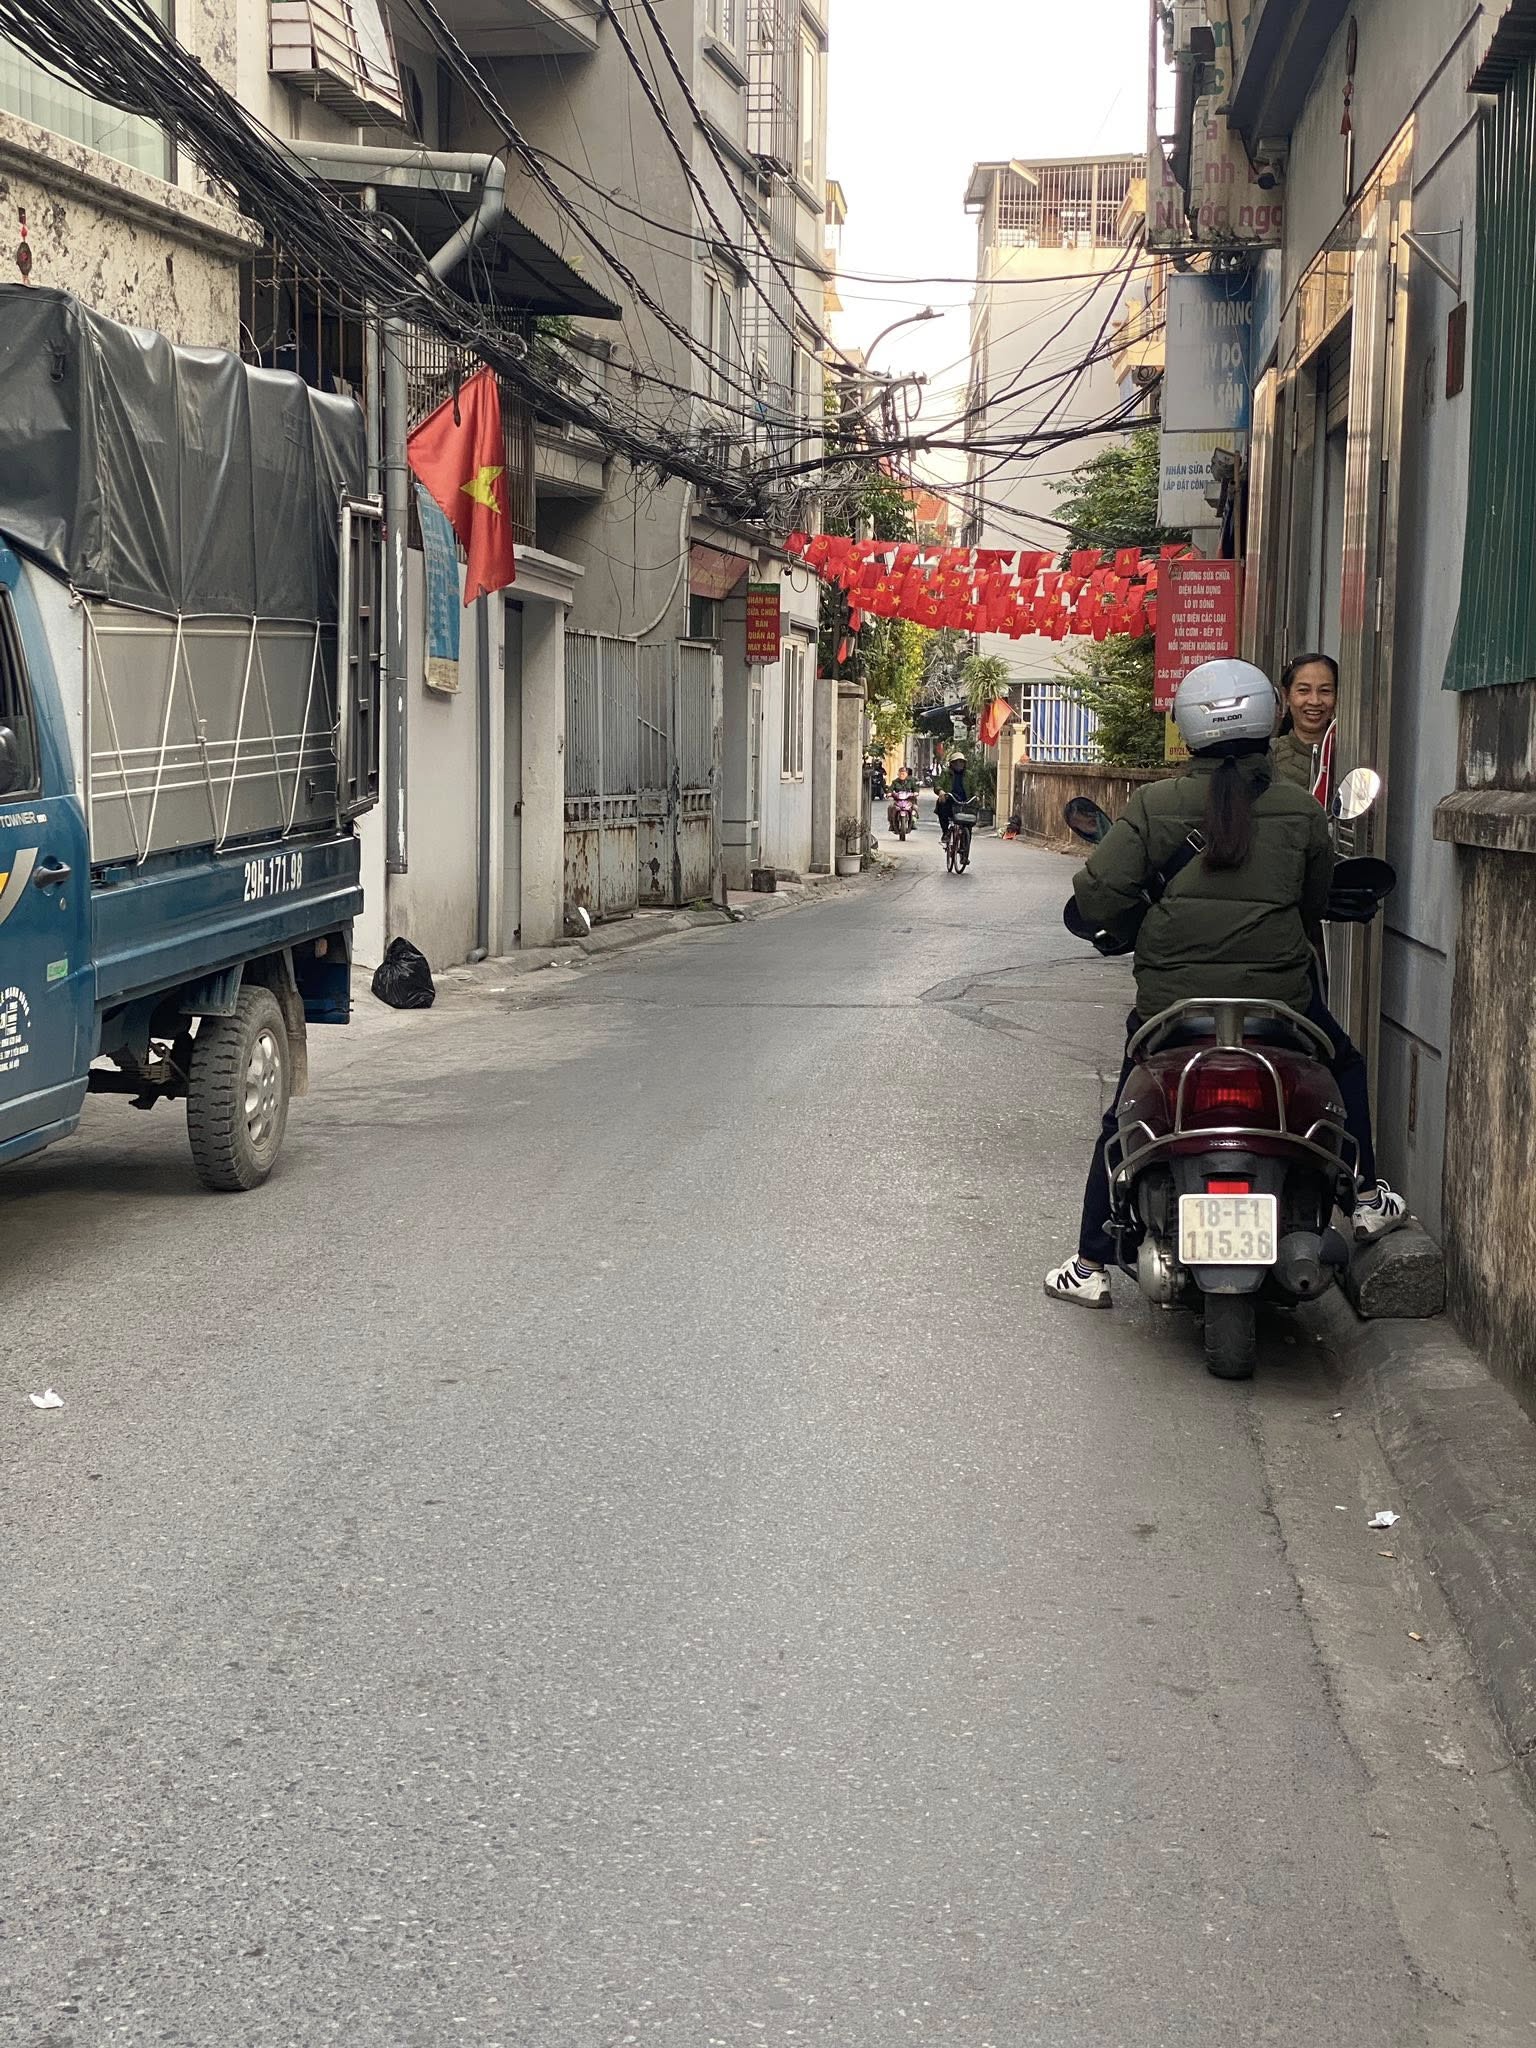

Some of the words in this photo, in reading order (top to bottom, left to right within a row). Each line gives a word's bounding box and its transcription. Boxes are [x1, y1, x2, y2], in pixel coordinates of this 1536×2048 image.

[1212, 713, 1242, 723] FALCON
[0, 811, 37, 828] TOWNER
[244, 851, 303, 902] 29H-171.98
[1195, 1199, 1260, 1228] 18-F1
[1186, 1230, 1271, 1259] 115.36
